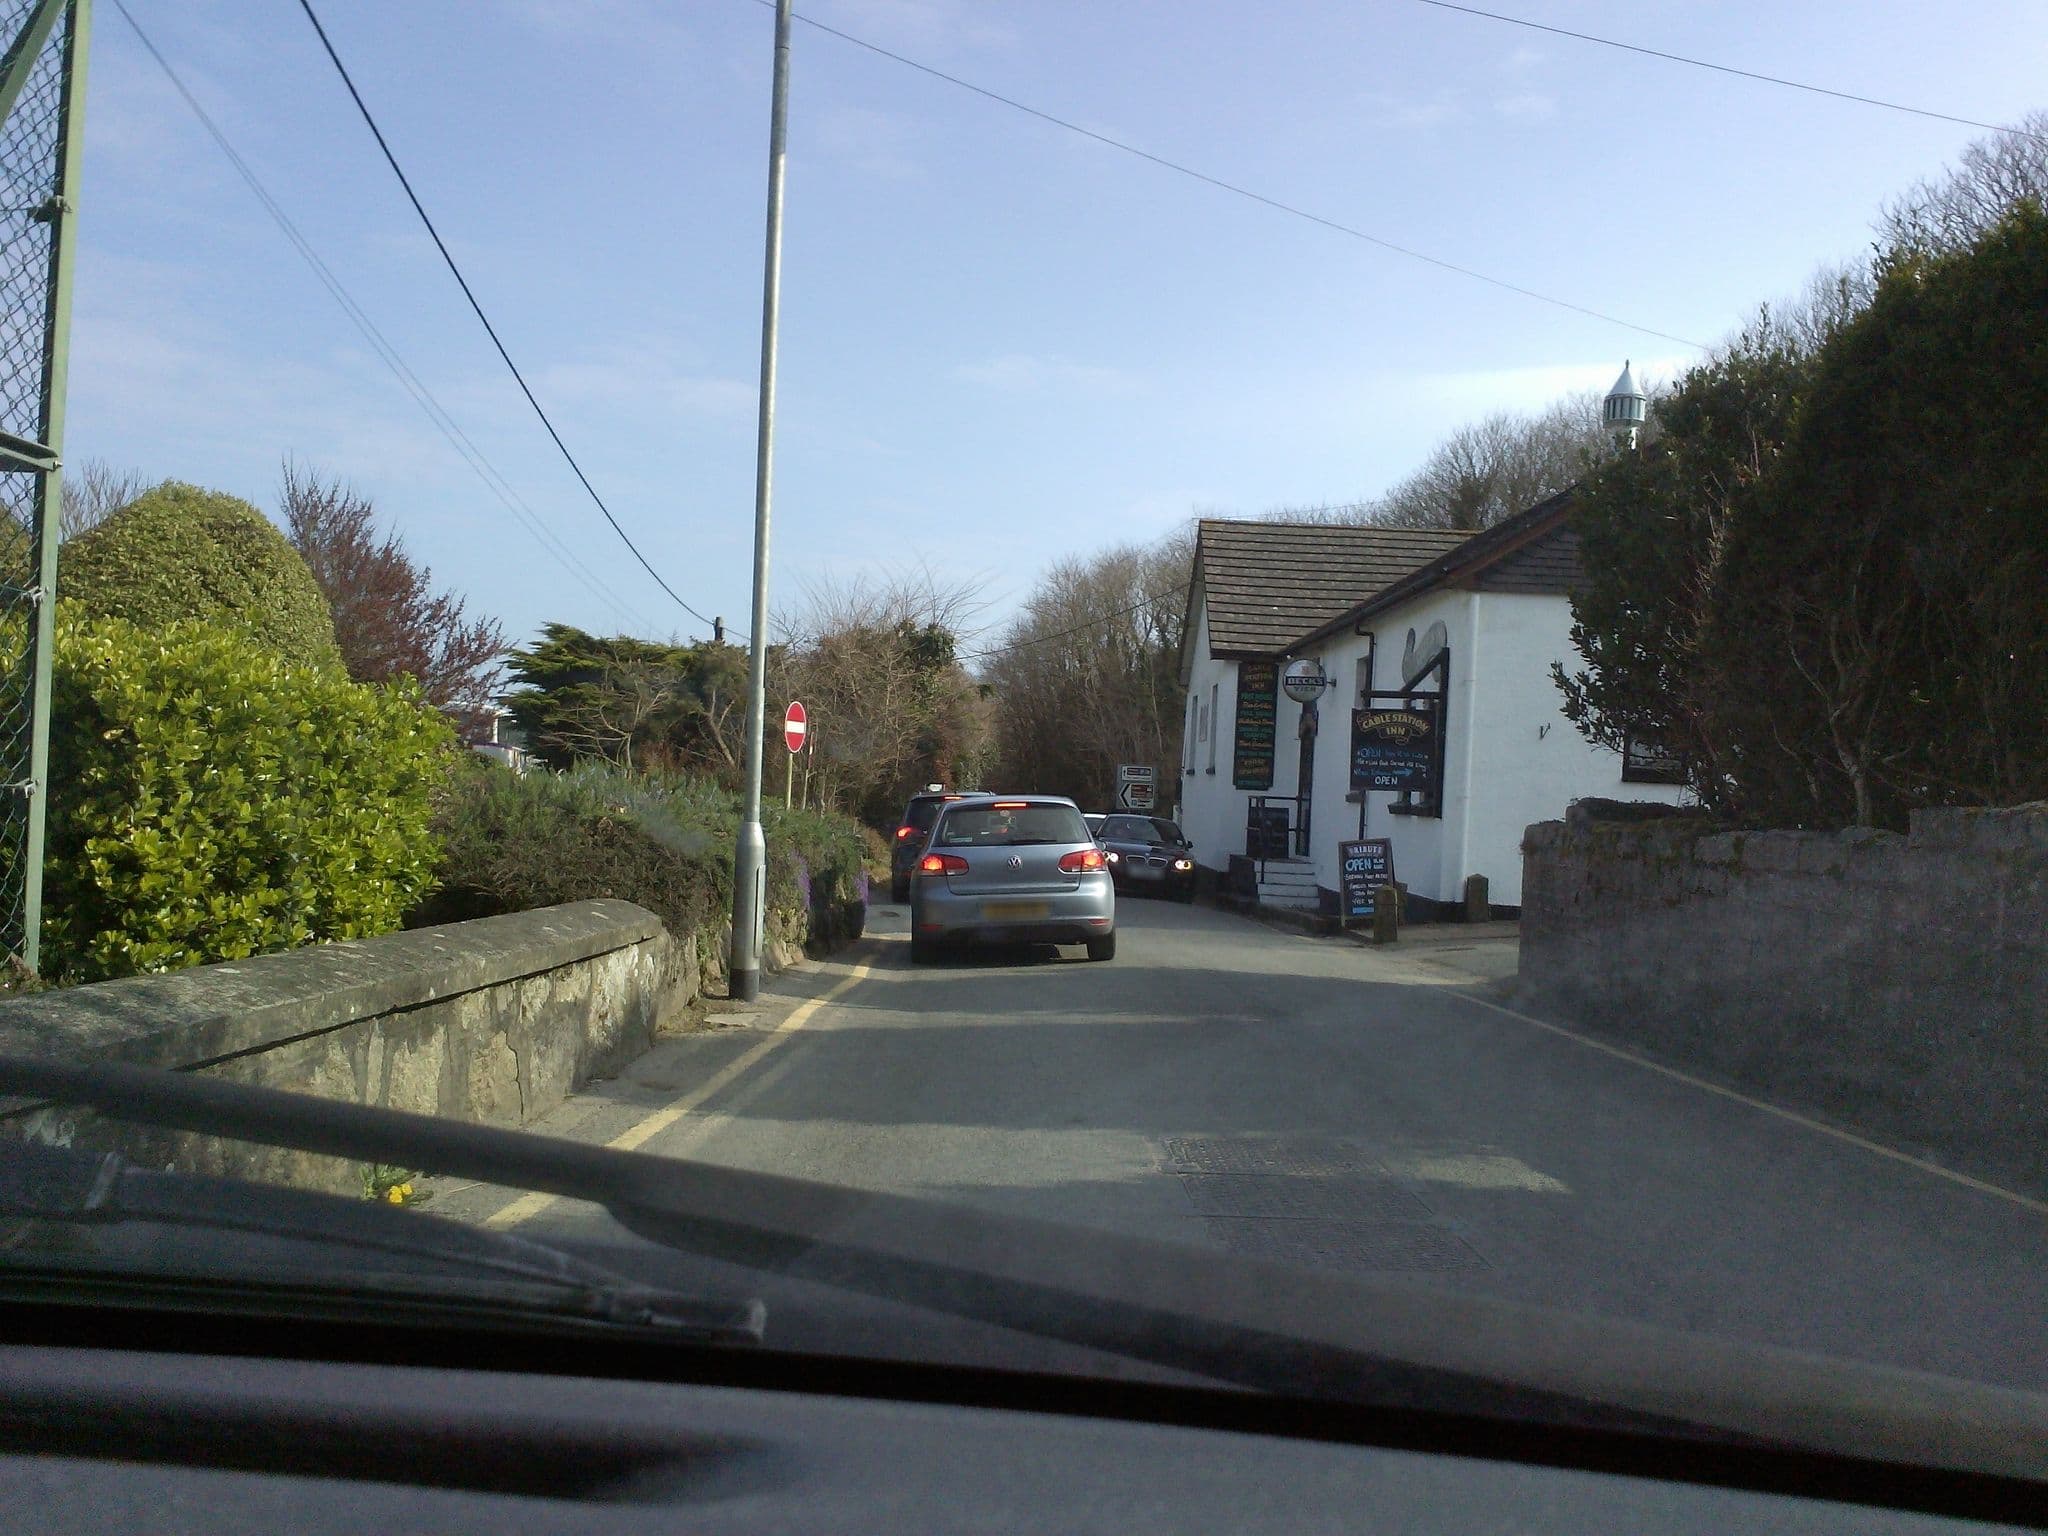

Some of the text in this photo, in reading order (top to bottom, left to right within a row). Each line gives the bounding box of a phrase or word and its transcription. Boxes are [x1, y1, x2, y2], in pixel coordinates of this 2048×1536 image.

[1362, 714, 1430, 732] CABLE STATION
[1386, 727, 1406, 736] INN
[1375, 776, 1398, 785] OPEN
[1348, 846, 1382, 854] TRIBUTE
[1346, 859, 1371, 871] OPEN
